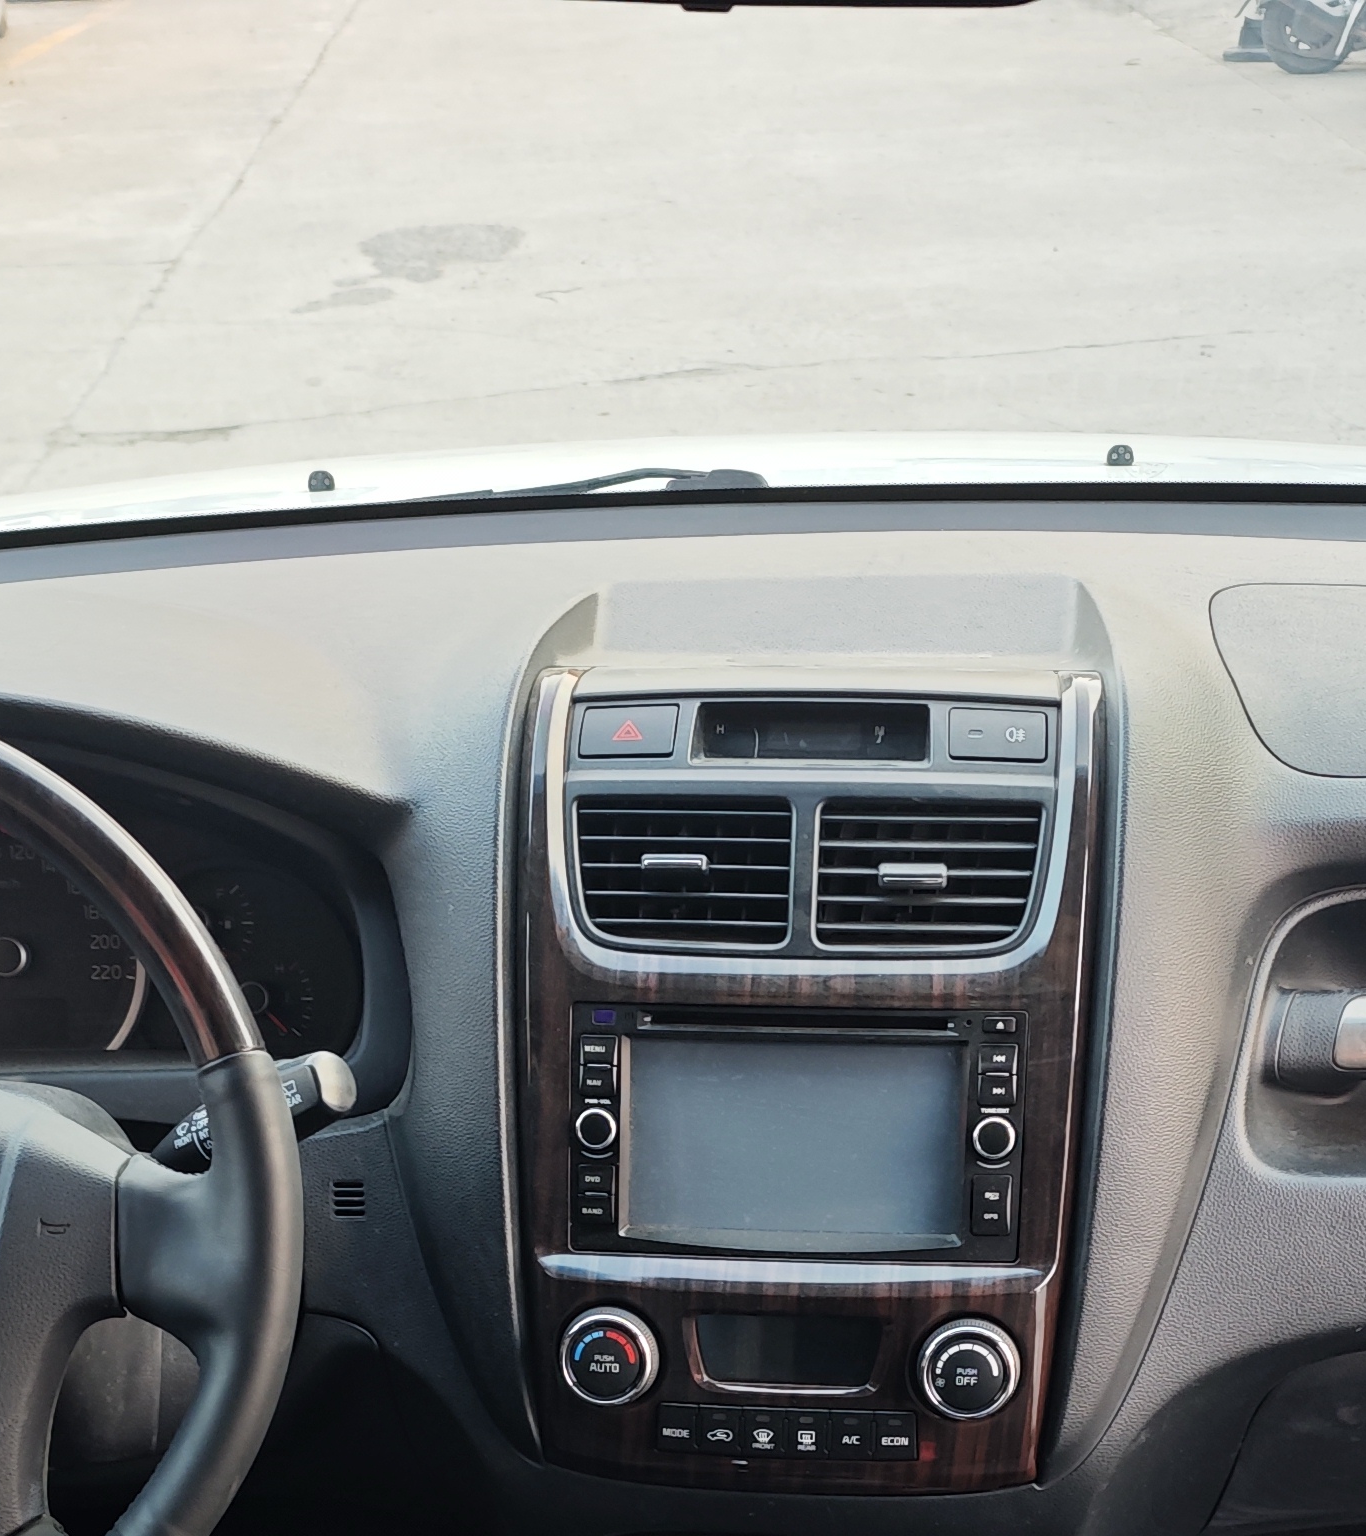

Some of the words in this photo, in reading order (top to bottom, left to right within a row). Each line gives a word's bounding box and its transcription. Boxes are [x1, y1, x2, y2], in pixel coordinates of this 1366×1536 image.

[90, 934, 119, 950] 200
[90, 965, 122, 980] 220
[584, 1045, 606, 1053] MENU
[584, 1175, 601, 1183] DVD
[581, 1207, 604, 1215] BAND
[593, 1354, 615, 1362] PUSH
[588, 1362, 620, 1373] AUTO
[956, 1367, 978, 1375] PUSH
[955, 1376, 979, 1387] OFF
[662, 1427, 691, 1439] MODE
[841, 1435, 861, 1445] A/C
[881, 1437, 910, 1446] ECON
